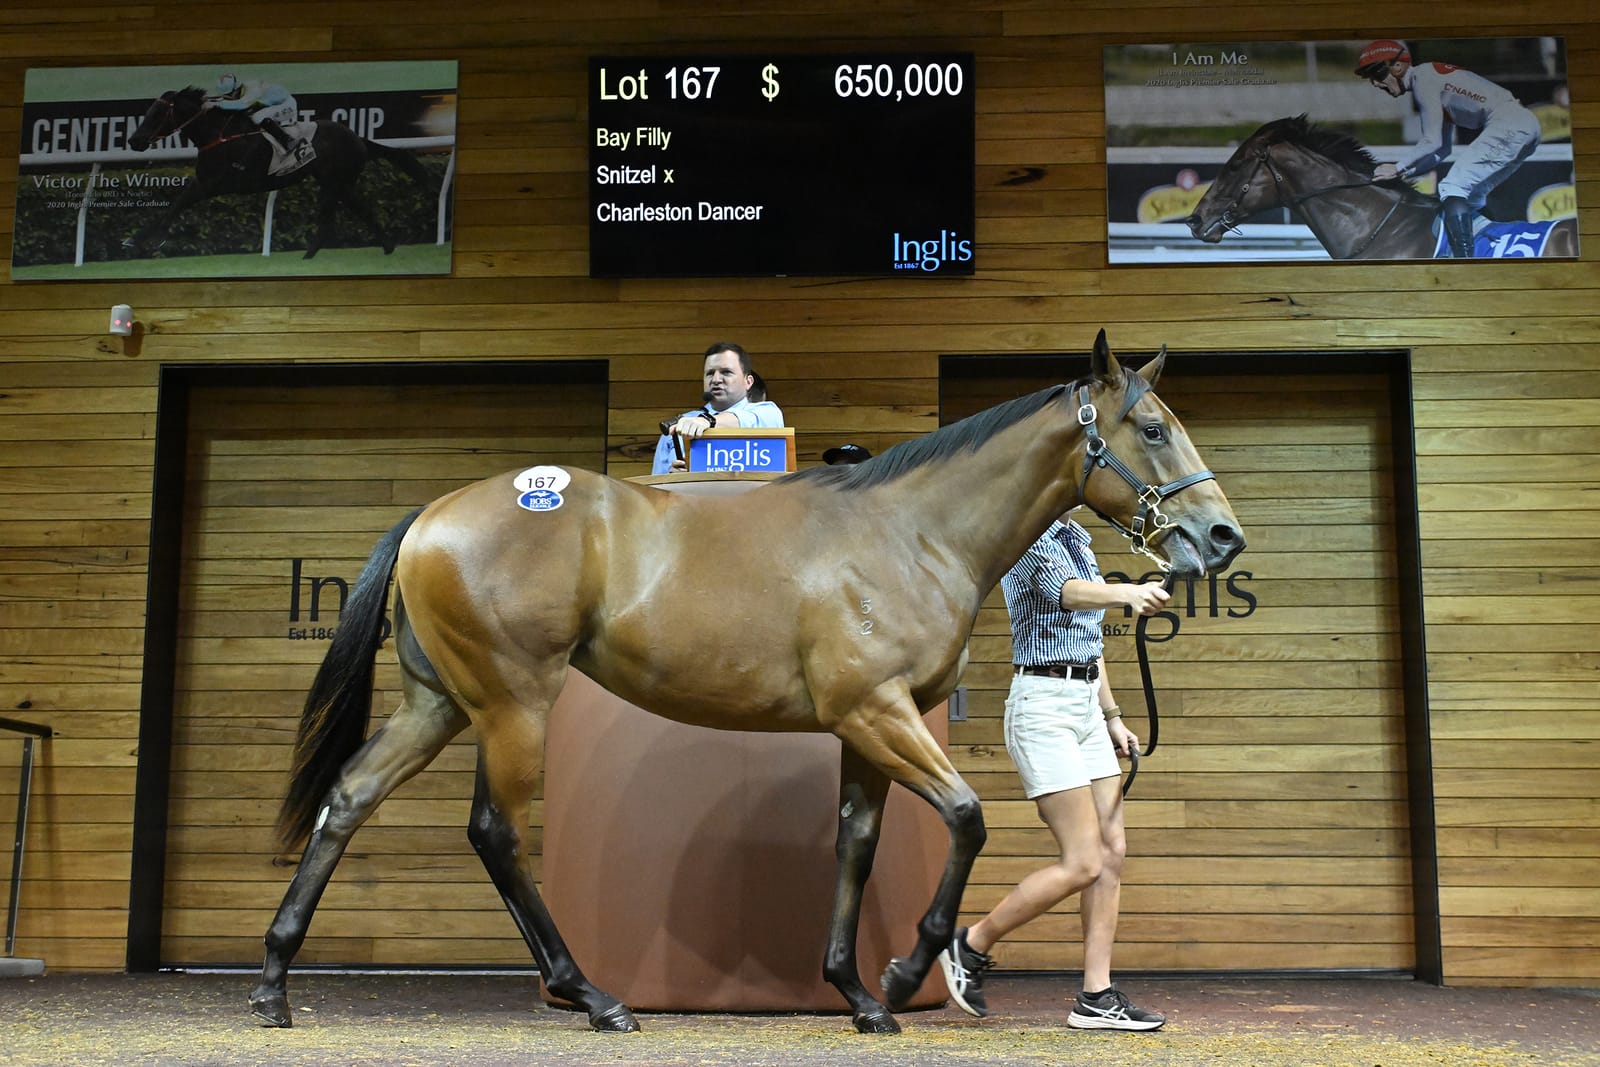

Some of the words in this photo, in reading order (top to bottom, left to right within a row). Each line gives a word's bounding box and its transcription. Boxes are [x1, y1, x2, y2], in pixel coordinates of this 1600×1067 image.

[1172, 52, 1177, 65] I
[1184, 51, 1214, 65] Am
[1220, 51, 1248, 65] Me
[600, 68, 649, 100] Lot
[664, 66, 721, 100] 167
[761, 63, 780, 103] $
[834, 62, 964, 102] 650,000
[596, 128, 631, 151] Bay
[636, 127, 672, 150] Filly
[32, 174, 84, 189] Victor
[90, 173, 120, 188] The
[125, 173, 189, 188] Winner
[596, 165, 656, 185] Snitzel
[663, 169, 674, 183] x
[47, 201, 66, 209] 2020
[89, 200, 118, 209] Premier
[118, 199, 135, 208] Sale
[136, 199, 170, 208] Graduate
[596, 202, 692, 222] Charleston
[698, 201, 764, 221] Dancer
[894, 229, 973, 272] Inglis
[1490, 232, 1541, 257] 15
[706, 440, 772, 472] Inglis
[528, 476, 557, 489] 167
[288, 627, 309, 640] Est
[310, 627, 336, 640] 186
